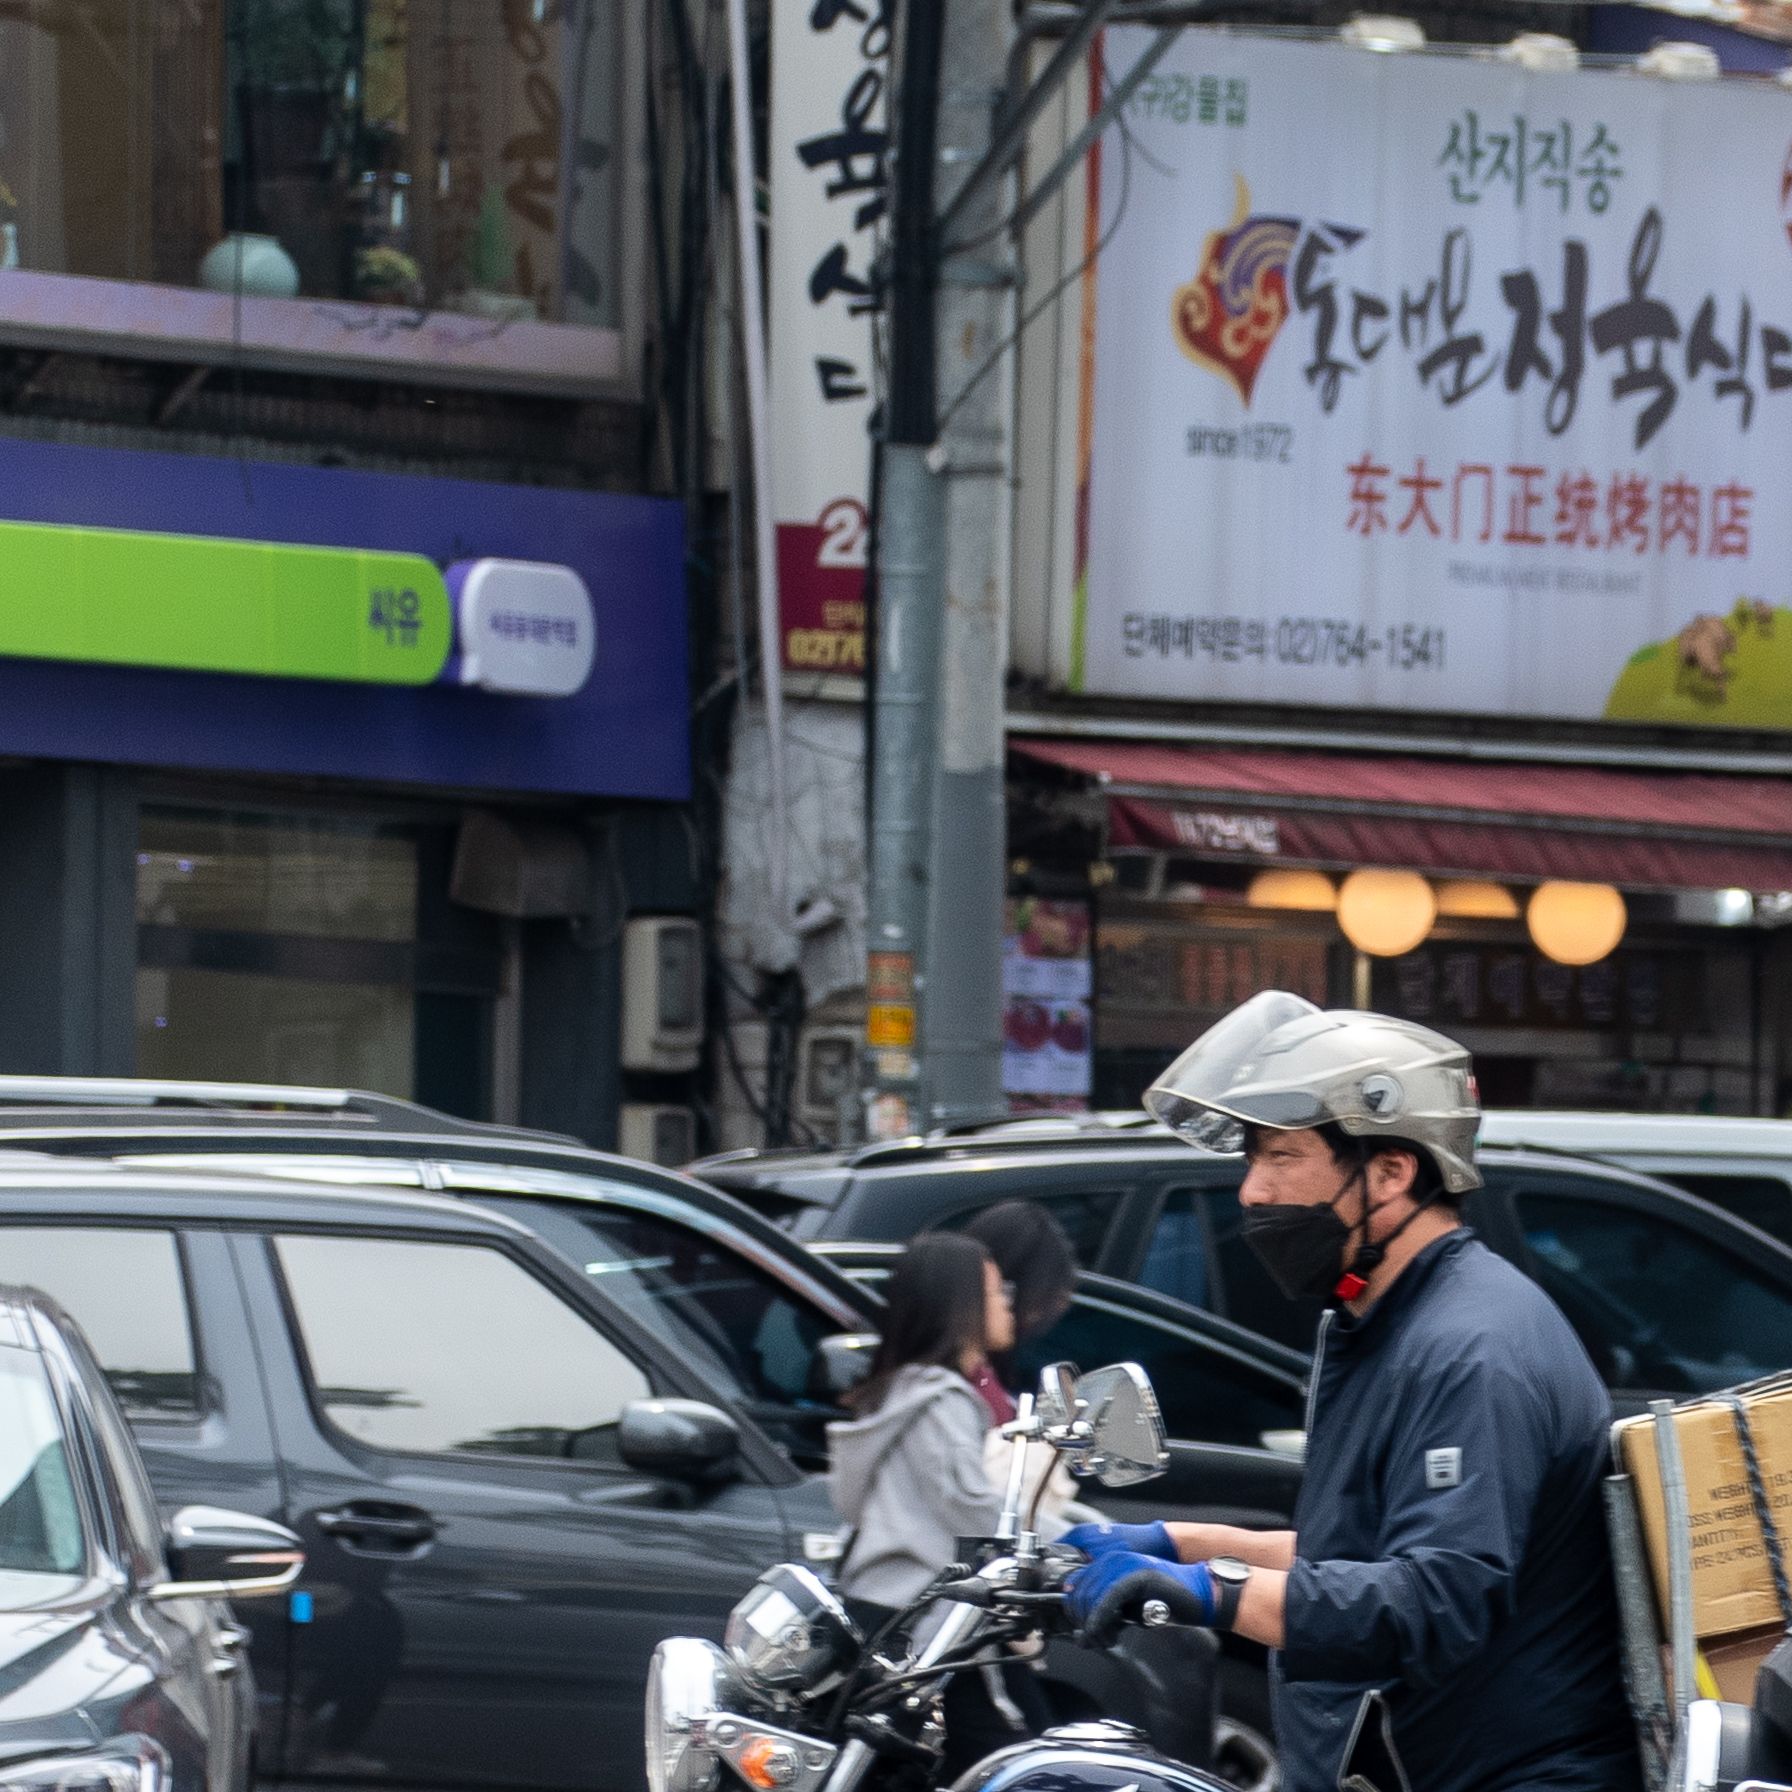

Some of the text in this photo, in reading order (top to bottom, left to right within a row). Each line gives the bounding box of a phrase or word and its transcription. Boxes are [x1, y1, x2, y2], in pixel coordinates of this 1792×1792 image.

[1438, 110, 1624, 214] 산지직송
[1346, 452, 1755, 558] 东大门正统烤肉店
